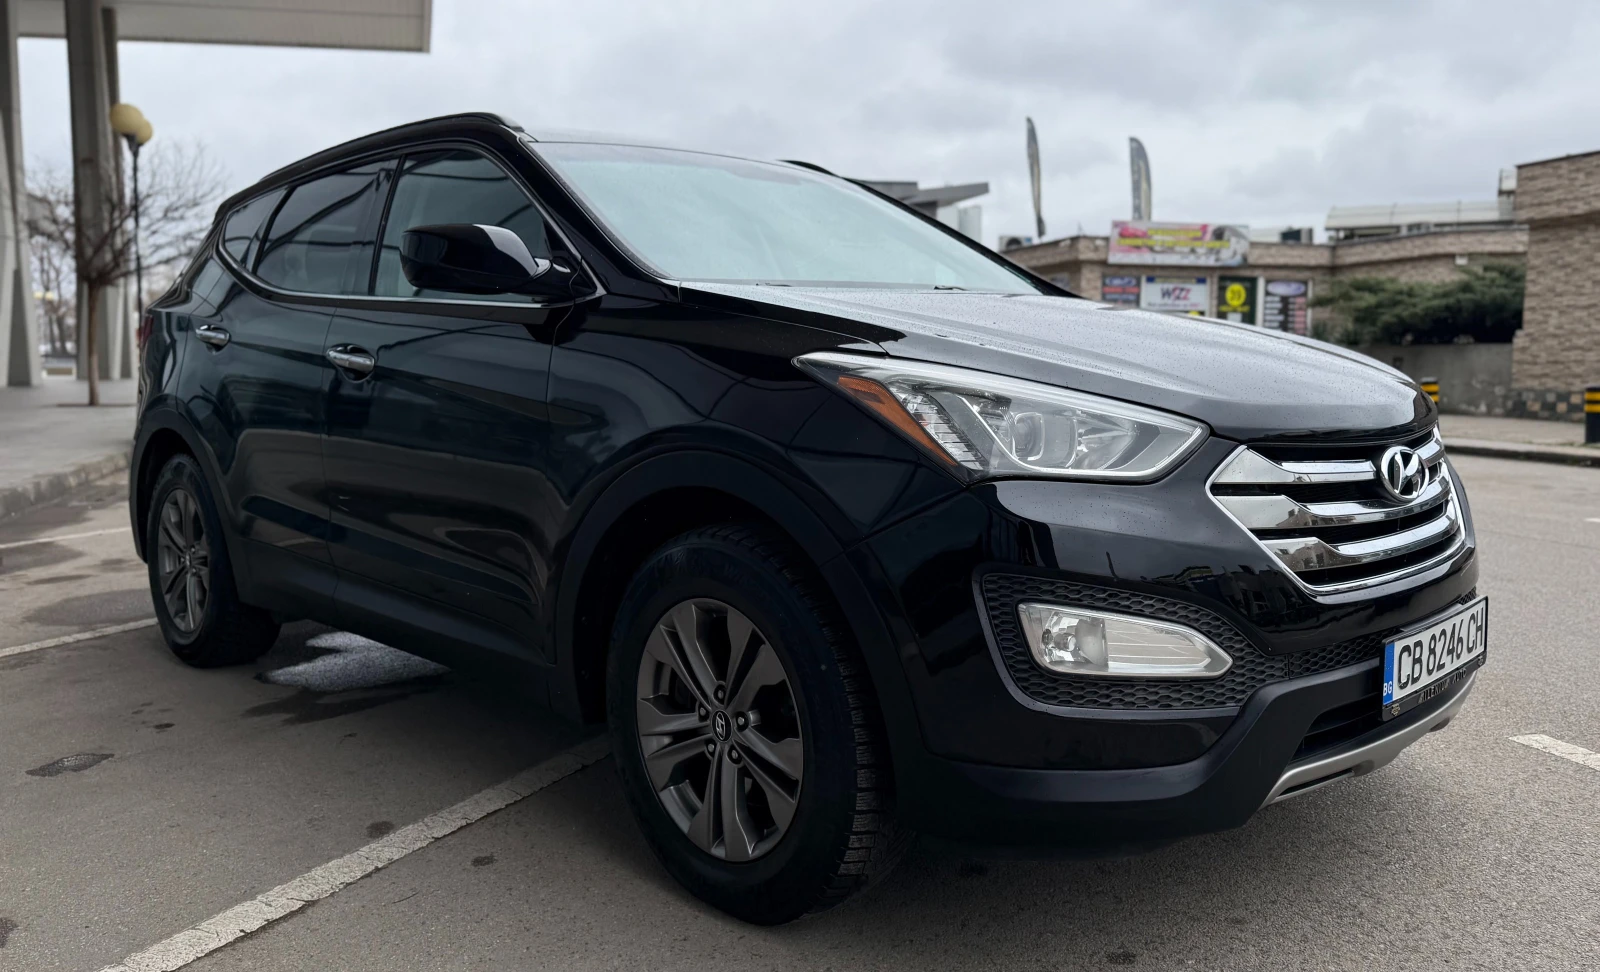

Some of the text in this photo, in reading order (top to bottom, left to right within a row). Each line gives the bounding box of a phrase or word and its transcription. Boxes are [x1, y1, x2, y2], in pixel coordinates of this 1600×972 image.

[1397, 606, 1484, 690] CB 8246 CH
[1383, 681, 1393, 697] BG
